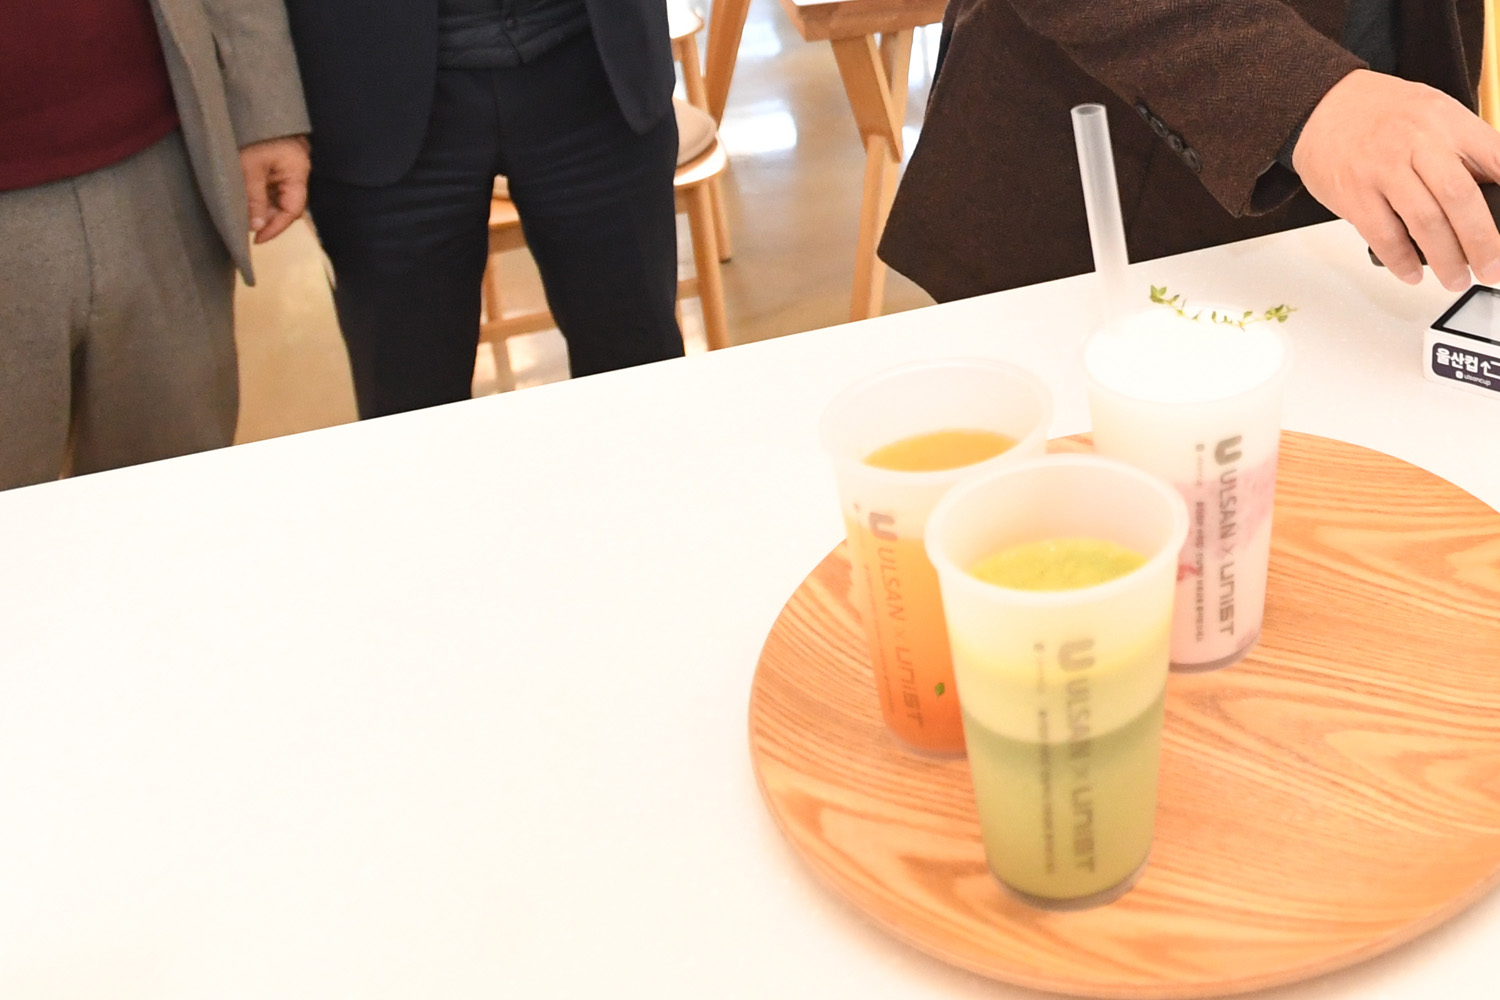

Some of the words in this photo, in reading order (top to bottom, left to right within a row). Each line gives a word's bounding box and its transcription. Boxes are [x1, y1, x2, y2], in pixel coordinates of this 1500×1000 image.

[1436, 347, 1478, 373] 울산컵
[1219, 468, 1237, 540] ULSAN
[877, 546, 907, 622] ULSAN
[1066, 677, 1091, 760] ULSAN
